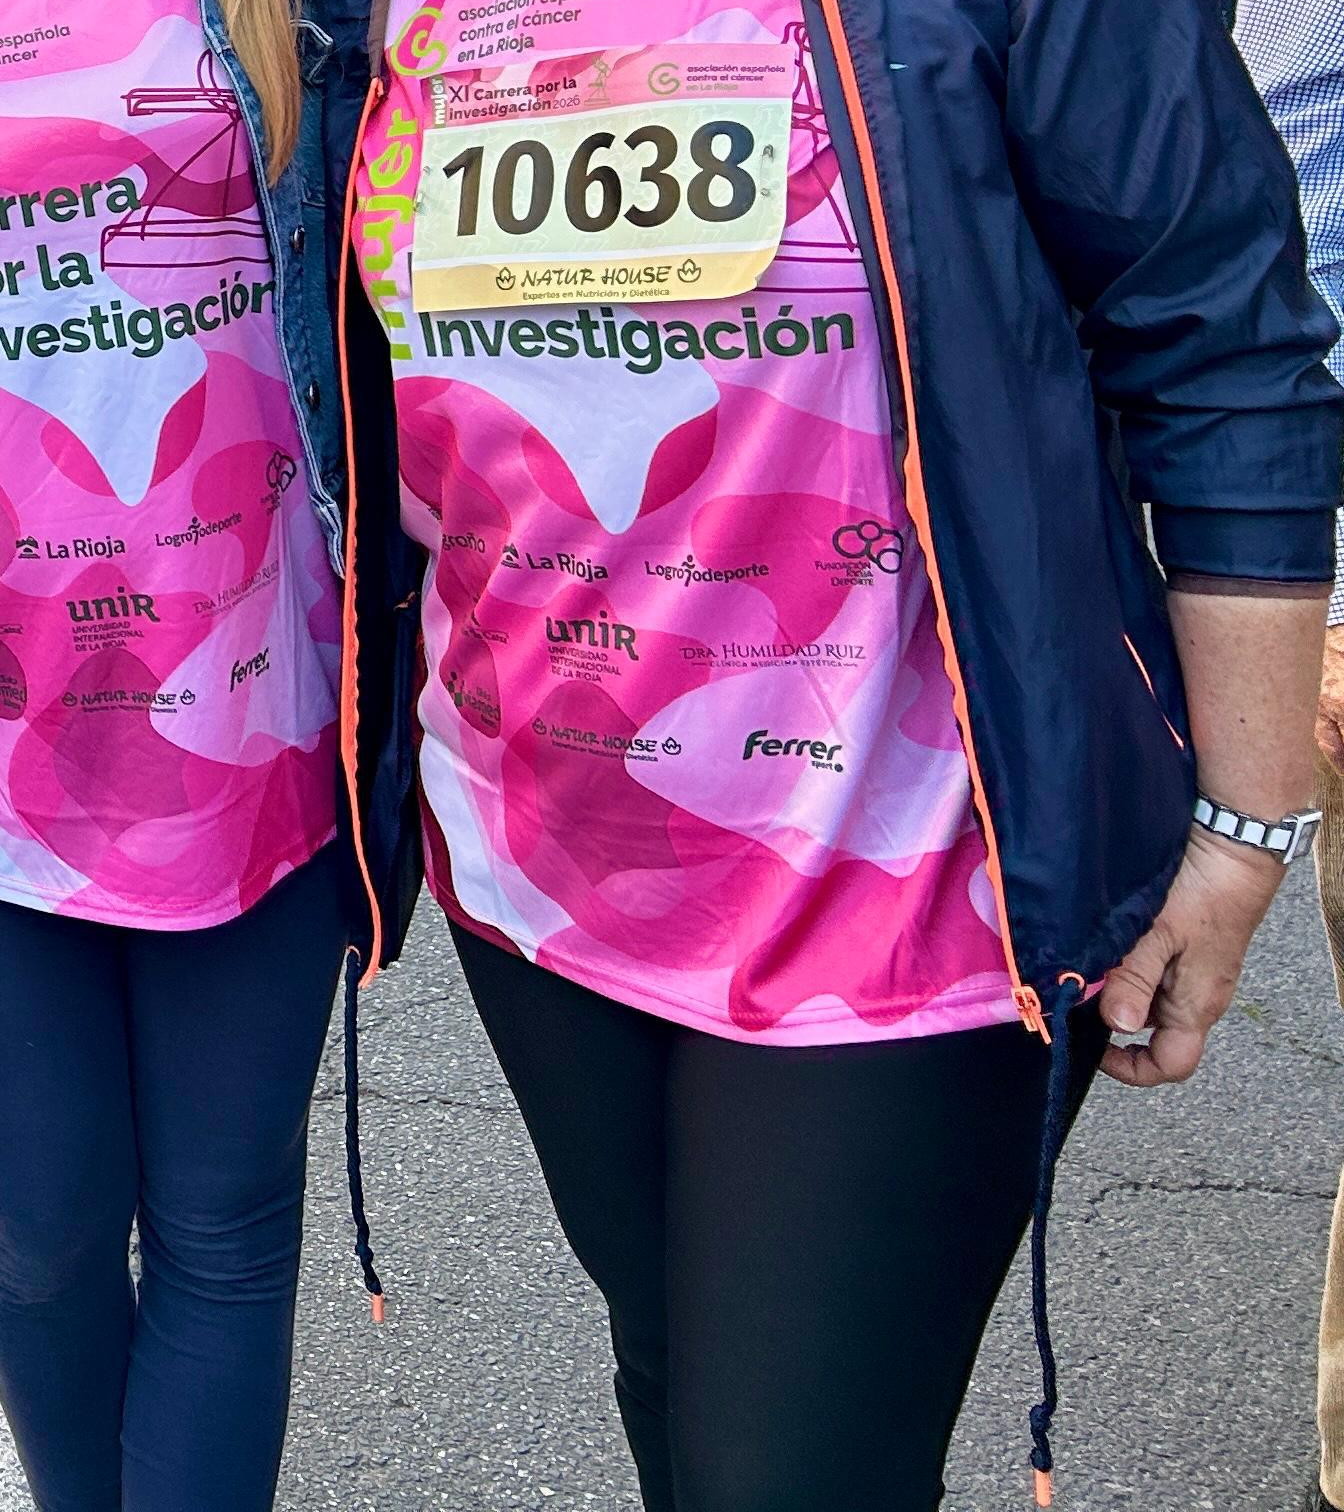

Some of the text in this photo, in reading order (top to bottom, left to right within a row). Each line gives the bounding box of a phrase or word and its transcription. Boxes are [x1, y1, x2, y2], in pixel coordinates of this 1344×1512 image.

[459, 7, 581, 43] contra el cáncer
[457, 34, 534, 62] en La Rioja
[687, 64, 786, 74] asociación española
[432, 77, 448, 125] mujer
[448, 77, 577, 104] XI Carrera por la
[552, 95, 581, 110] 2026
[443, 120, 757, 237] 10638
[38, 245, 93, 291] la
[520, 265, 672, 287] NATUR HOUSE
[523, 291, 560, 301] Expertos
[576, 289, 619, 298] Nutrición
[630, 288, 669, 297] Dietética
[419, 304, 854, 375] Investigación
[46, 535, 125, 559] La Rioja
[526, 552, 609, 583] La Rioja
[72, 621, 131, 634] UNIVERSIDAD
[548, 646, 608, 663] UNIVERSIDAD
[680, 642, 865, 660] DRA HUMILDAD RUIZ
[550, 725, 599, 746] NATUR
[603, 733, 658, 753] HOUSE
